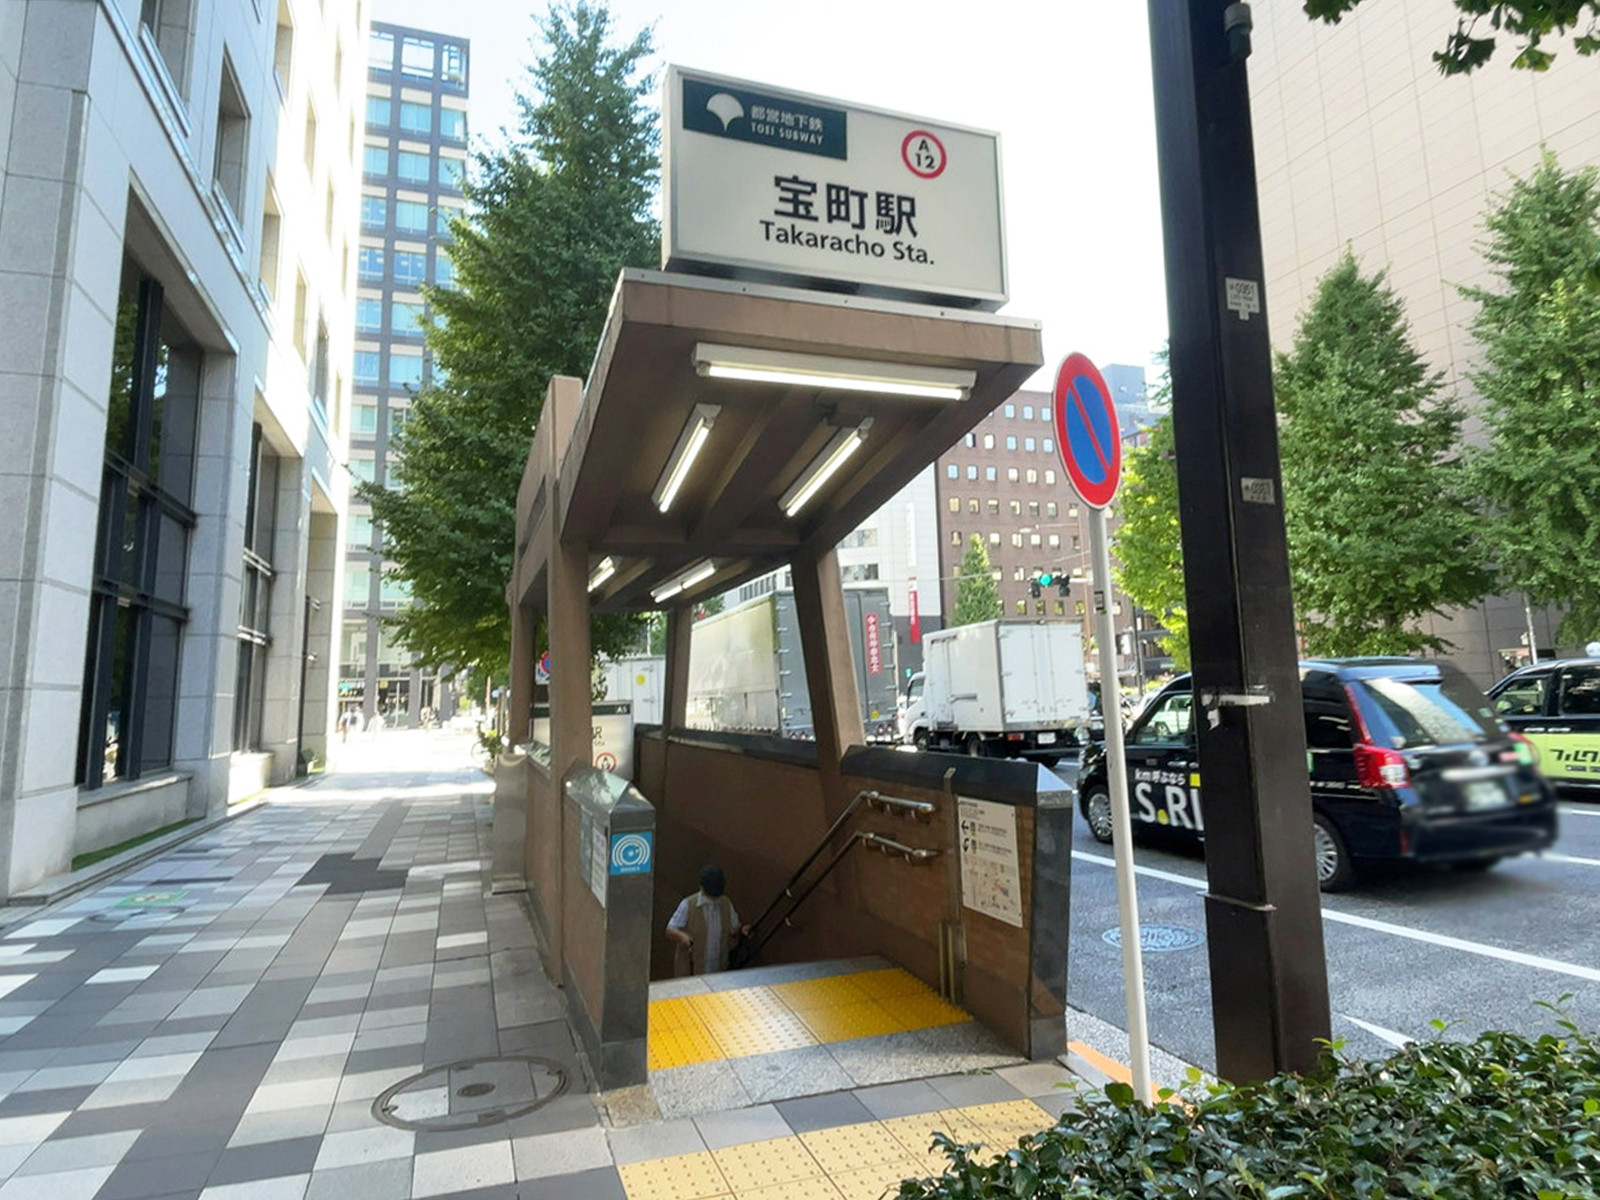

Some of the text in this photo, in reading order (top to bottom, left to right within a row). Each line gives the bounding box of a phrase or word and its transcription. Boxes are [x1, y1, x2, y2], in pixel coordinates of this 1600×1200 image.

[751, 105, 824, 133] 都営地下鉄
[751, 122, 825, 146] TOEI SUBWAY
[918, 139, 930, 153] A
[915, 152, 936, 170] 12
[773, 174, 919, 239] 宝町駅
[759, 219, 935, 266] Takaracho Sta.
